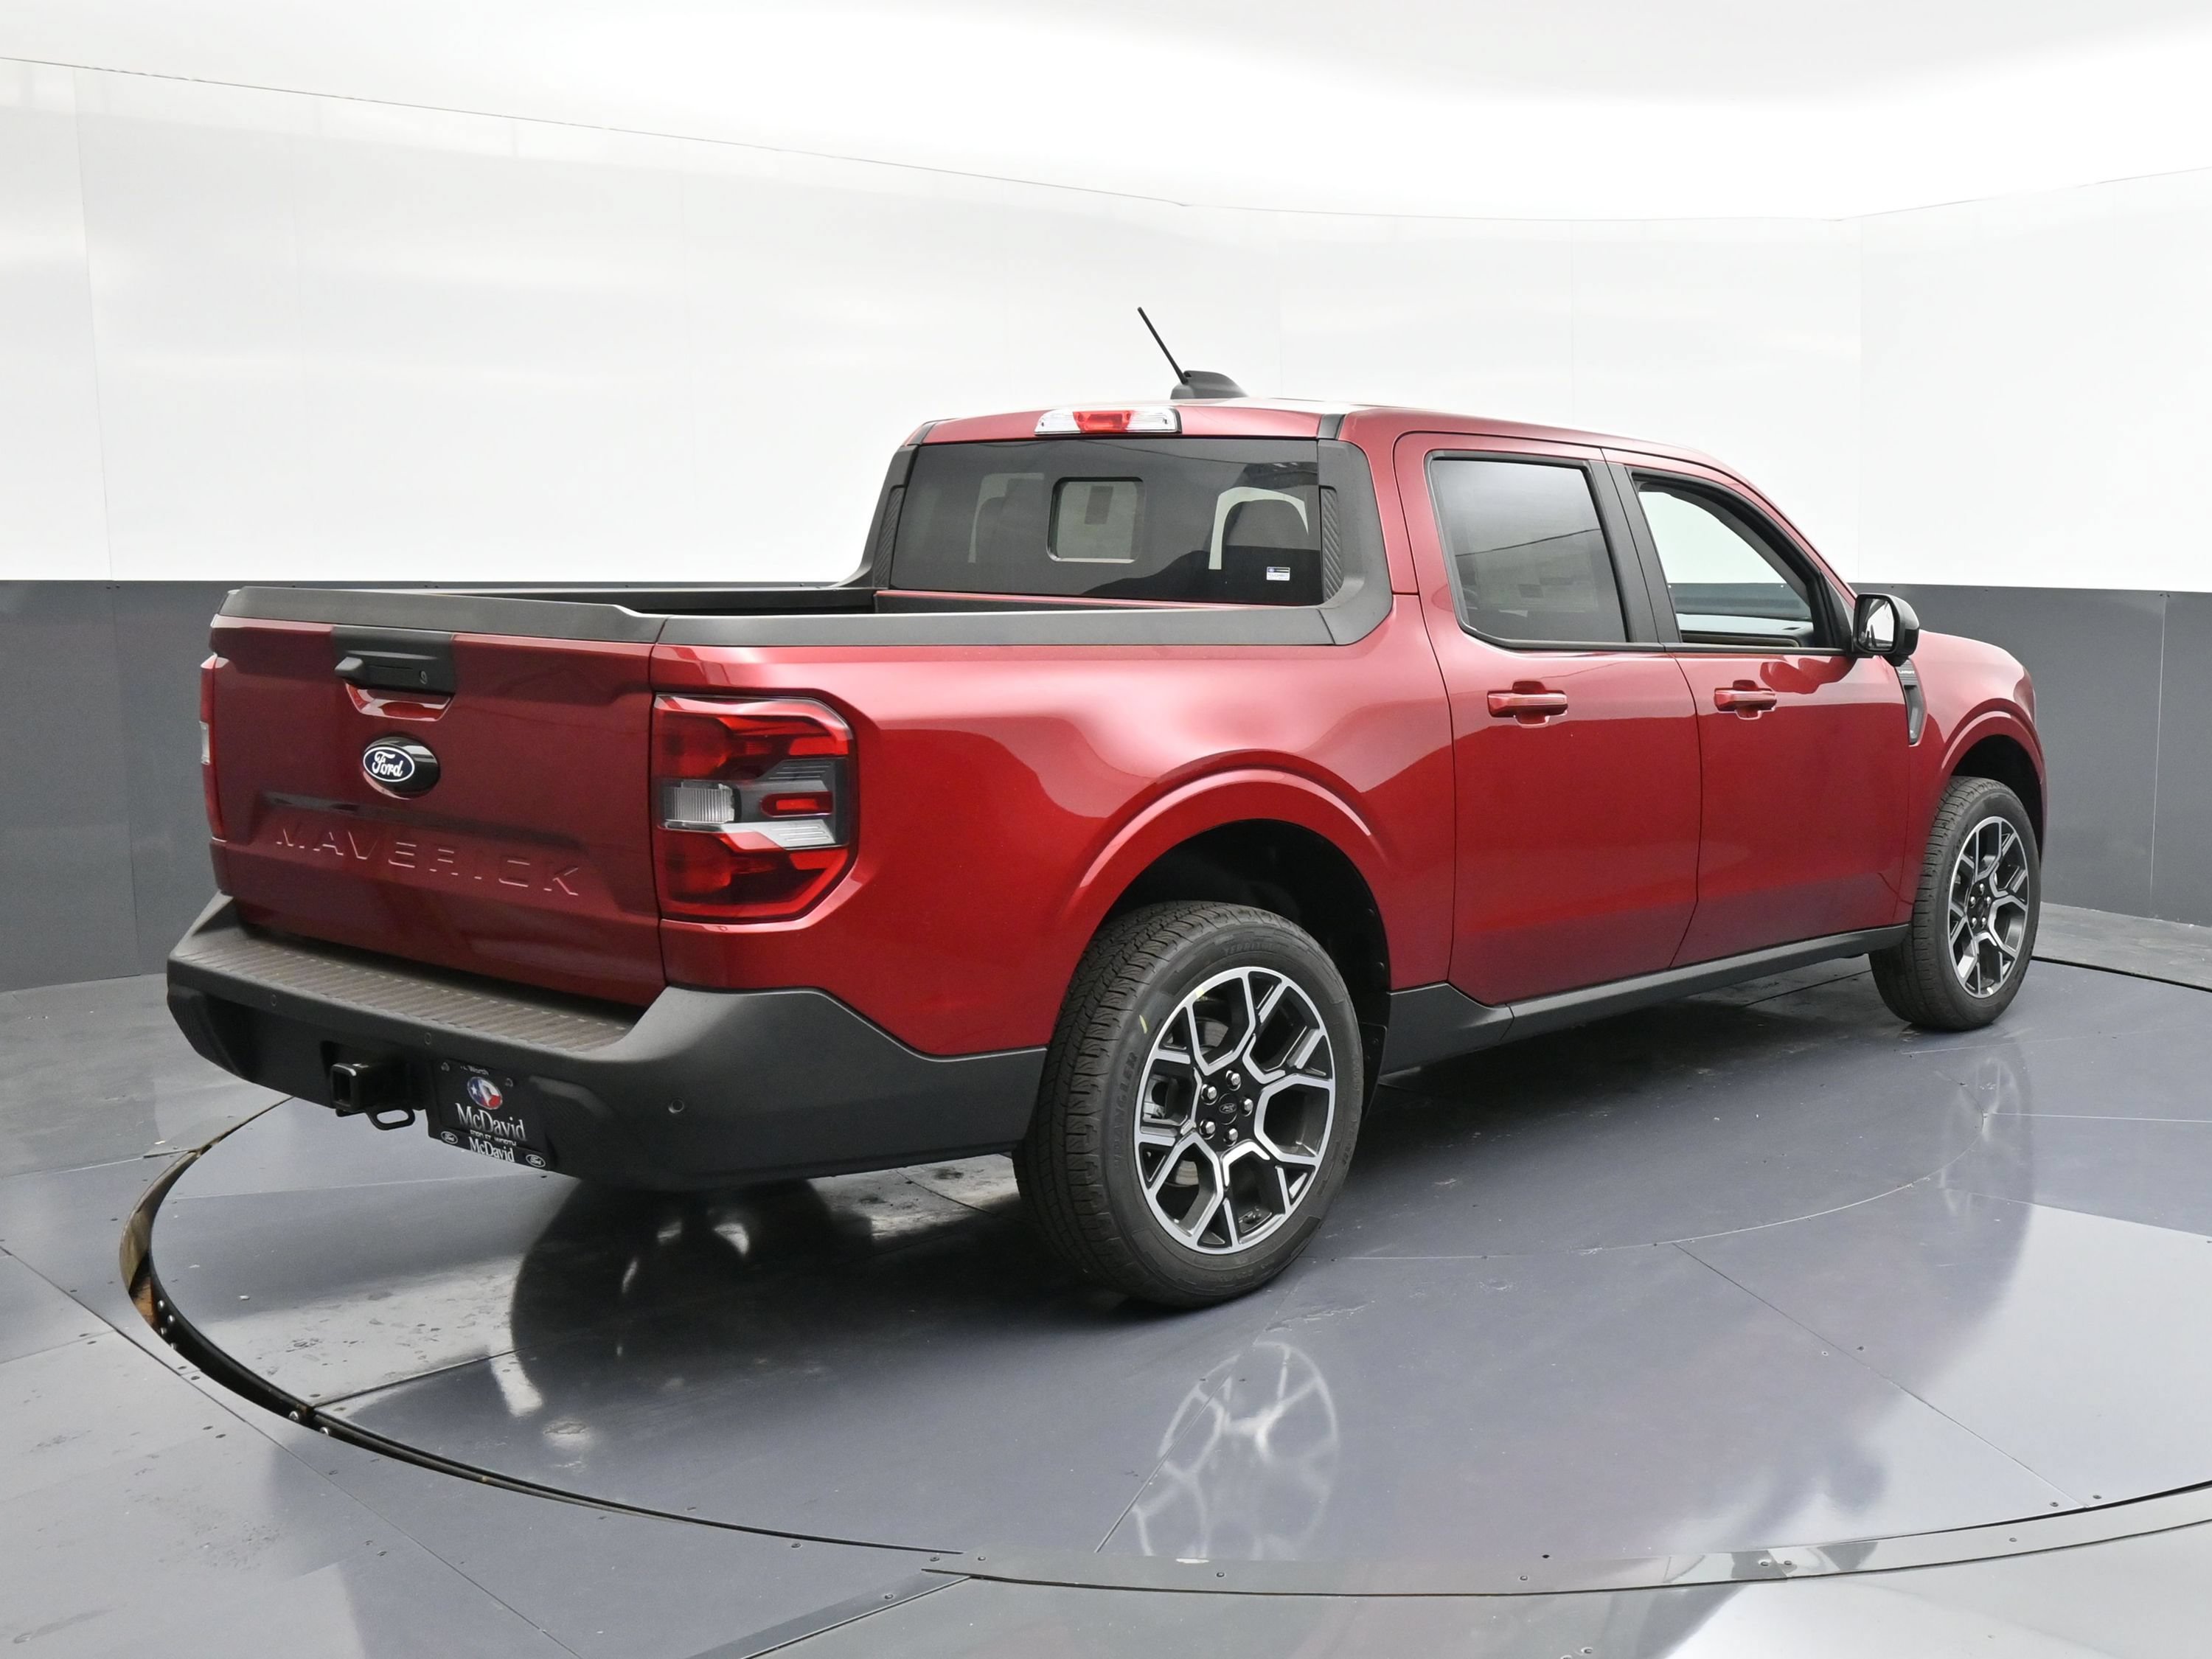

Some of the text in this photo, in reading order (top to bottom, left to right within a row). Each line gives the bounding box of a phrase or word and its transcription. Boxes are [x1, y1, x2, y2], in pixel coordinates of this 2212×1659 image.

[372, 751, 404, 777] Ford
[275, 821, 579, 897] MAVERICK
[455, 1102, 527, 1141] McDavid
[468, 1136, 515, 1163] McDavid
